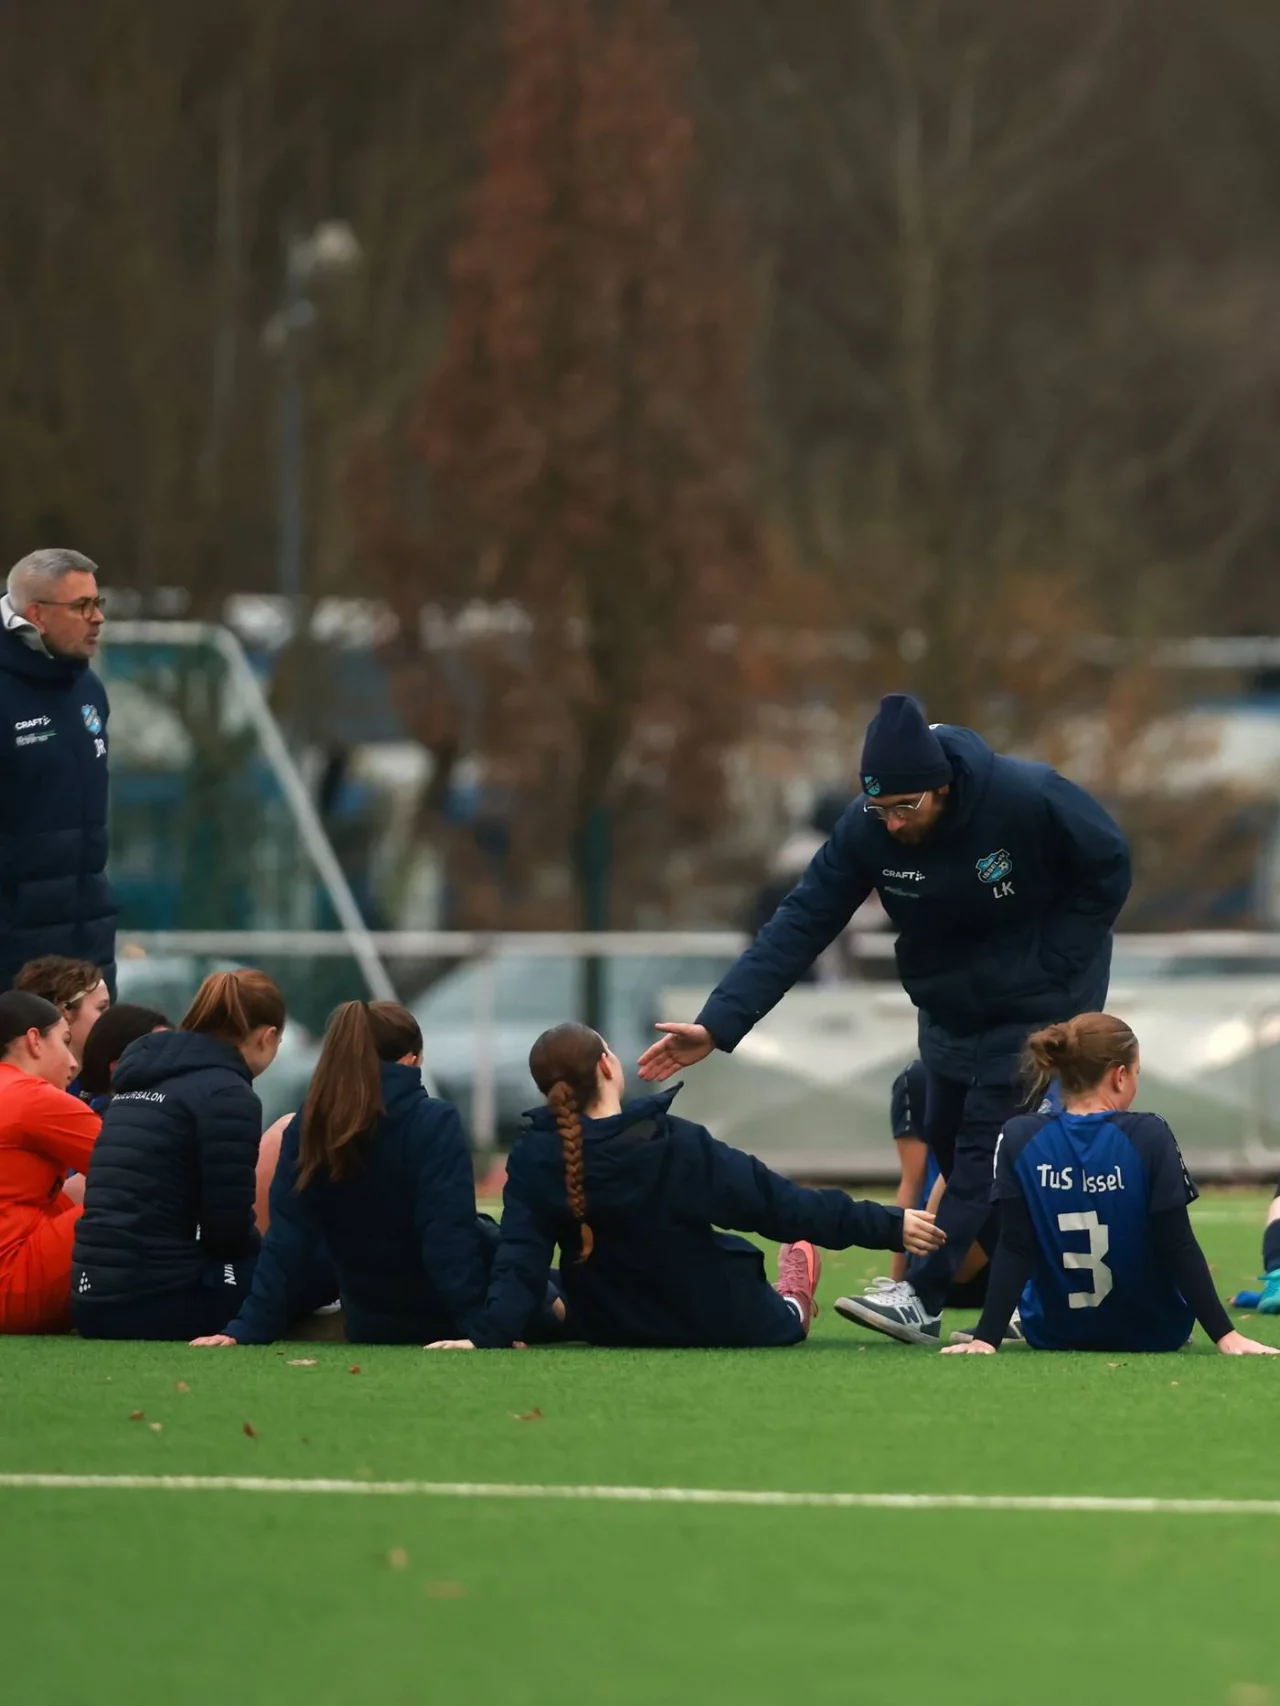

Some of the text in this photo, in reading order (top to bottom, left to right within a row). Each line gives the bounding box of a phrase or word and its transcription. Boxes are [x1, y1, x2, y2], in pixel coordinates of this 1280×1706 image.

[15, 717, 43, 730] CRAFT
[882, 868, 916, 880] CRAFT
[993, 881, 1015, 899] LK
[1037, 1163, 1125, 1193] TuS Issel
[1057, 1210, 1114, 1309] 3
